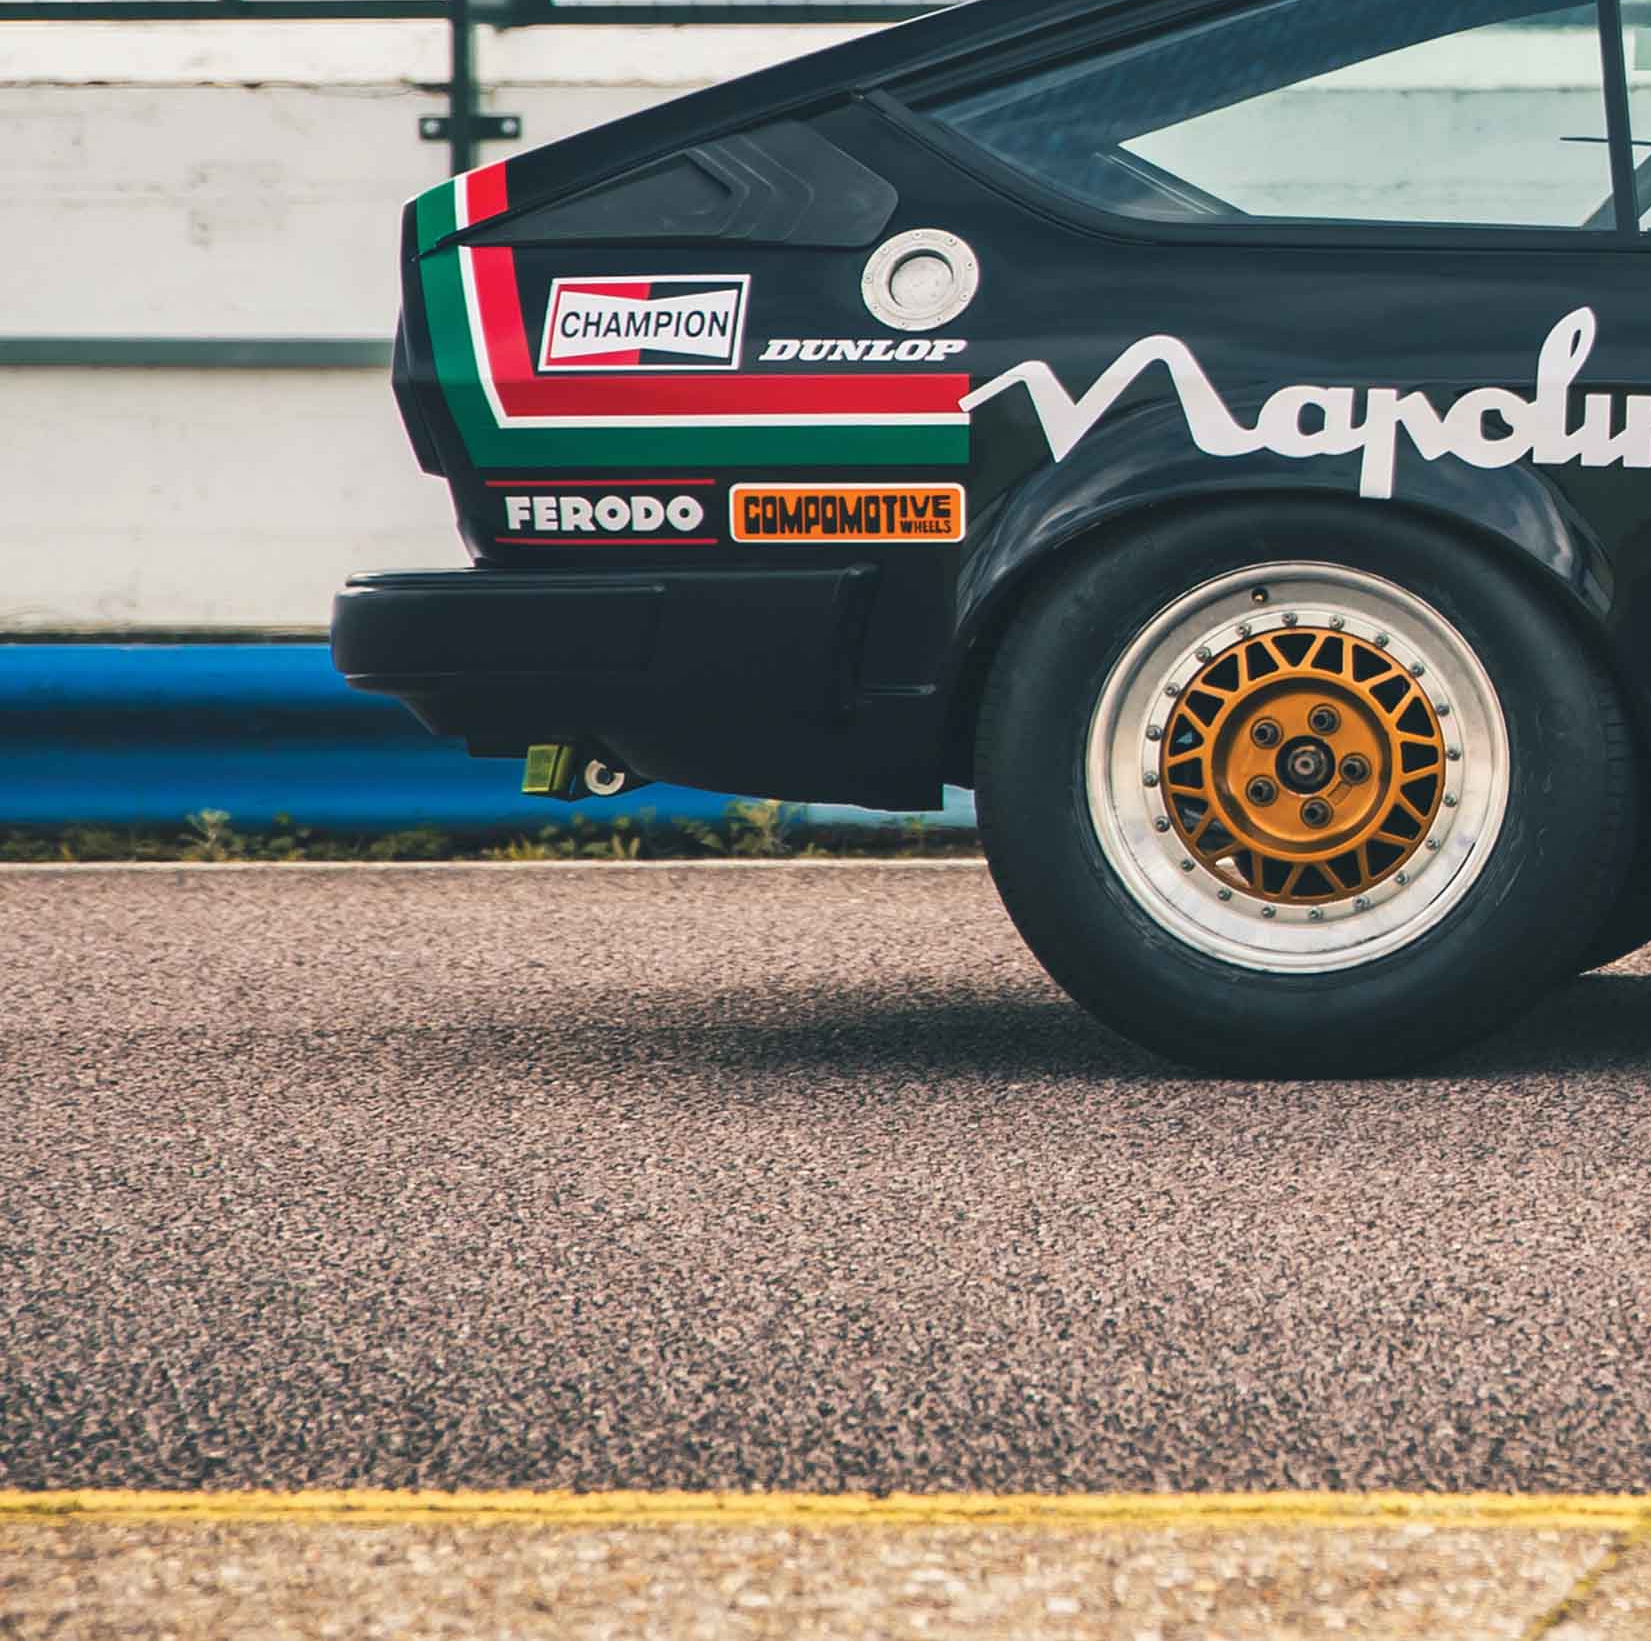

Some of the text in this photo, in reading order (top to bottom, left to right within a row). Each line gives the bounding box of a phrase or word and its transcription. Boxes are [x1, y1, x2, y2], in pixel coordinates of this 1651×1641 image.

[560, 310, 730, 338] CHAMPION
[757, 338, 968, 362] DUNLOP
[505, 495, 704, 532] FERODO
[744, 495, 952, 535] COMPOMOTIVE
[900, 519, 952, 534] WHEELS
